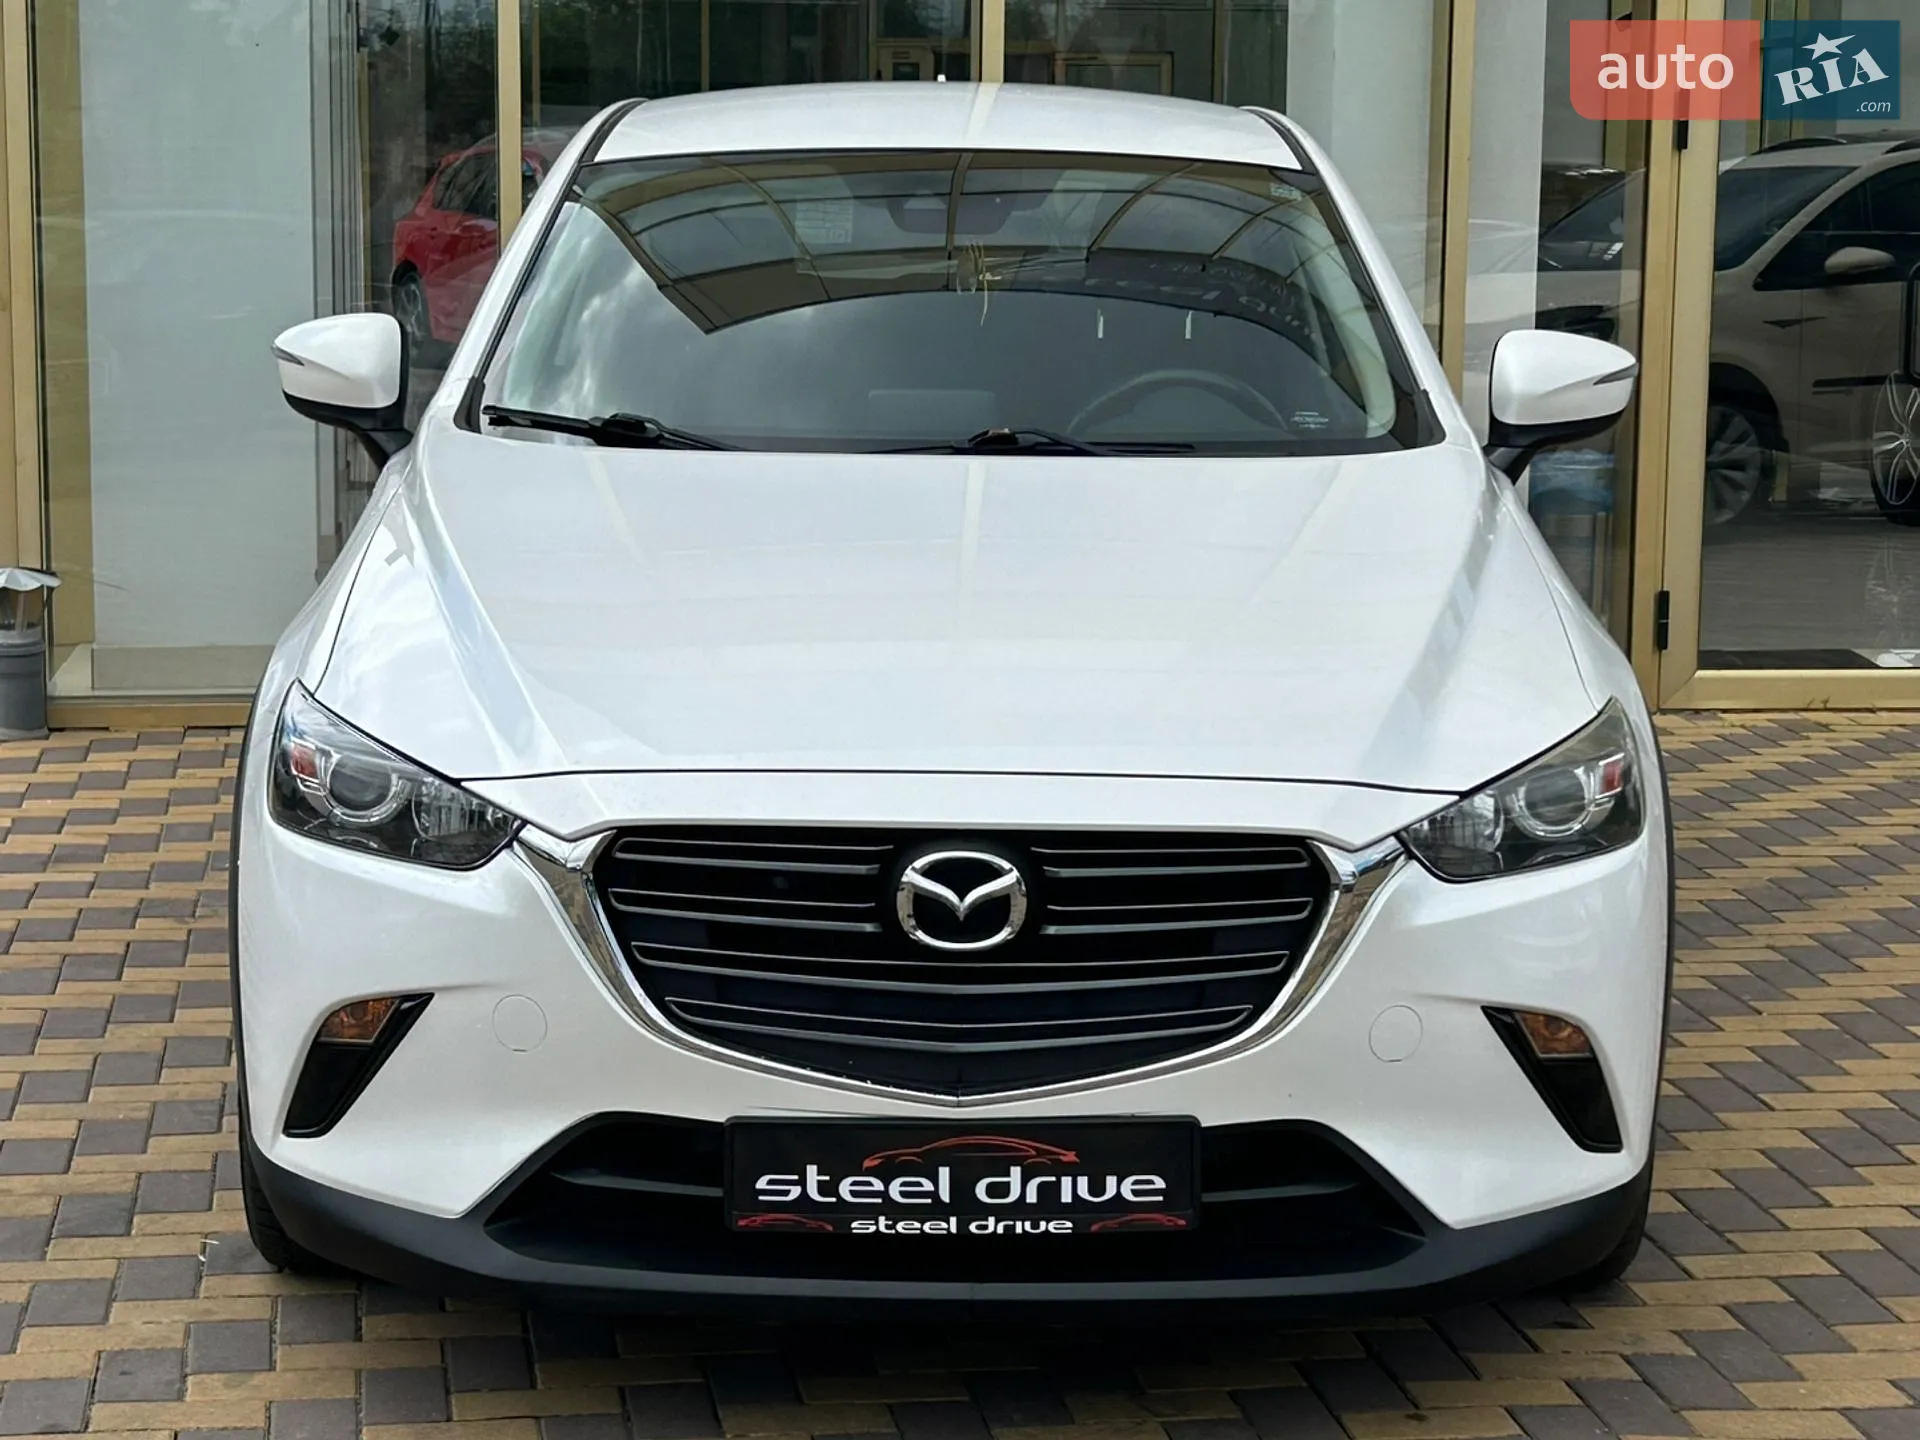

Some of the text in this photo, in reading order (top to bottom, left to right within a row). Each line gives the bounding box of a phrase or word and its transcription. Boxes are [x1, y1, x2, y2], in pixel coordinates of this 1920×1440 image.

[755, 1164, 1167, 1203] steel drive
[850, 1215, 1074, 1235] steel drive
